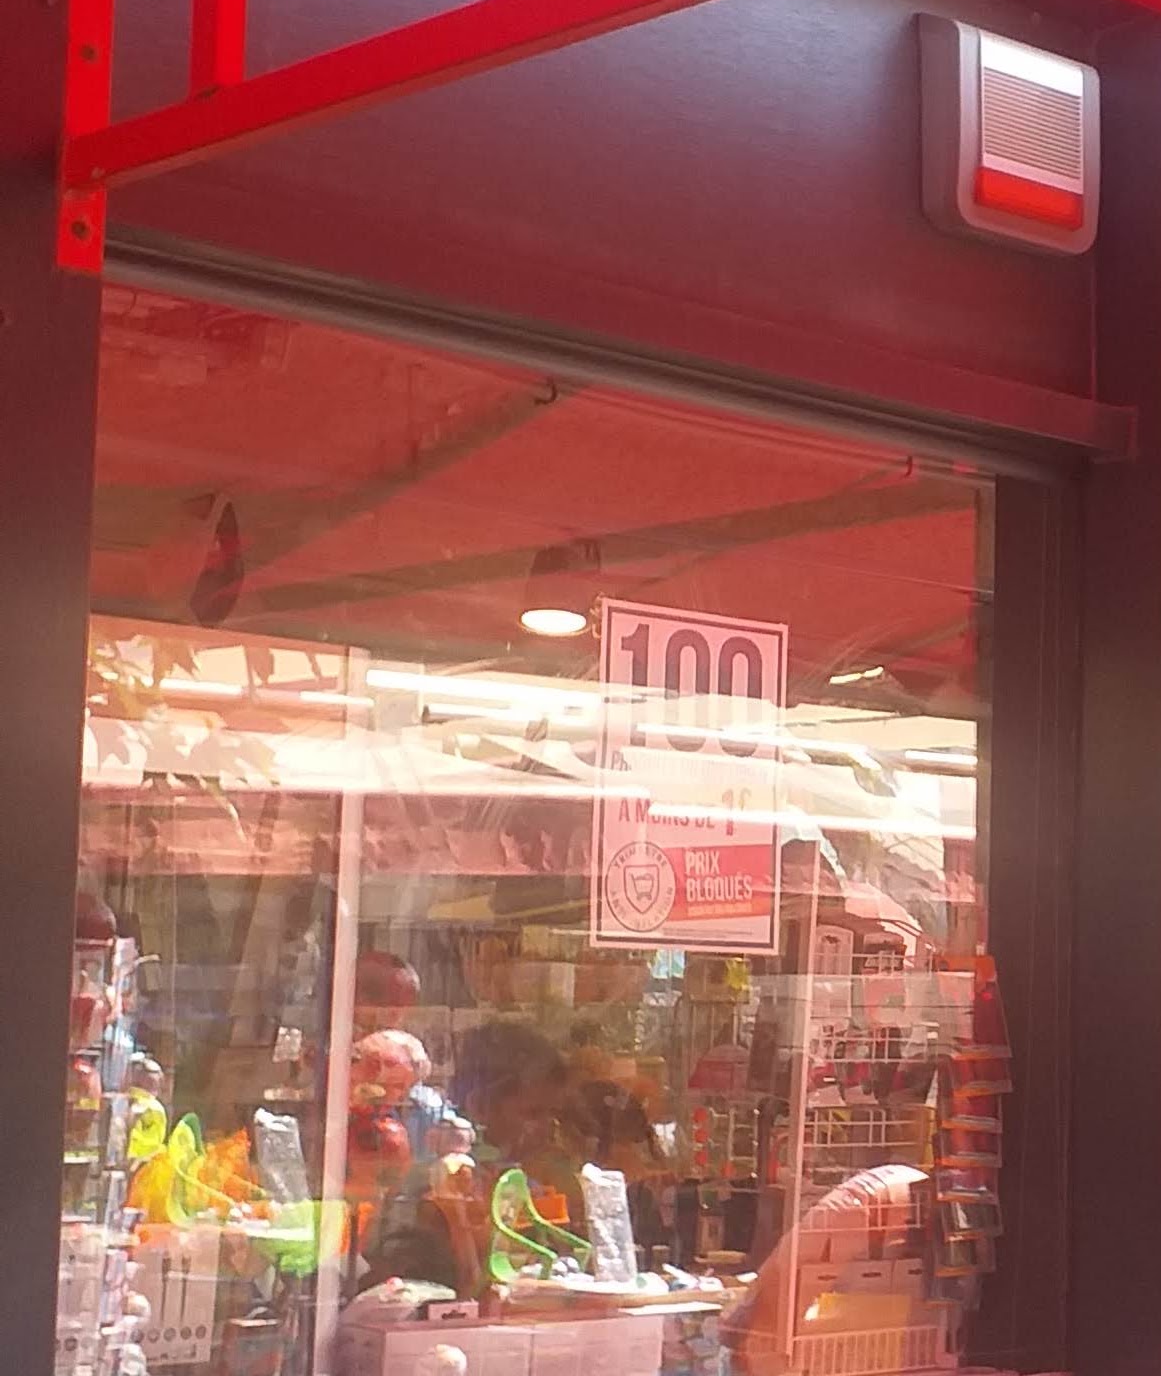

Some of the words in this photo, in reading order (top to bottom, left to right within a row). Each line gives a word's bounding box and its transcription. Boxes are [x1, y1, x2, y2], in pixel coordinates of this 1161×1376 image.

[620, 623, 763, 757] 100
[685, 849, 720, 874] PRIX
[686, 871, 753, 902] BLOQUÉS
